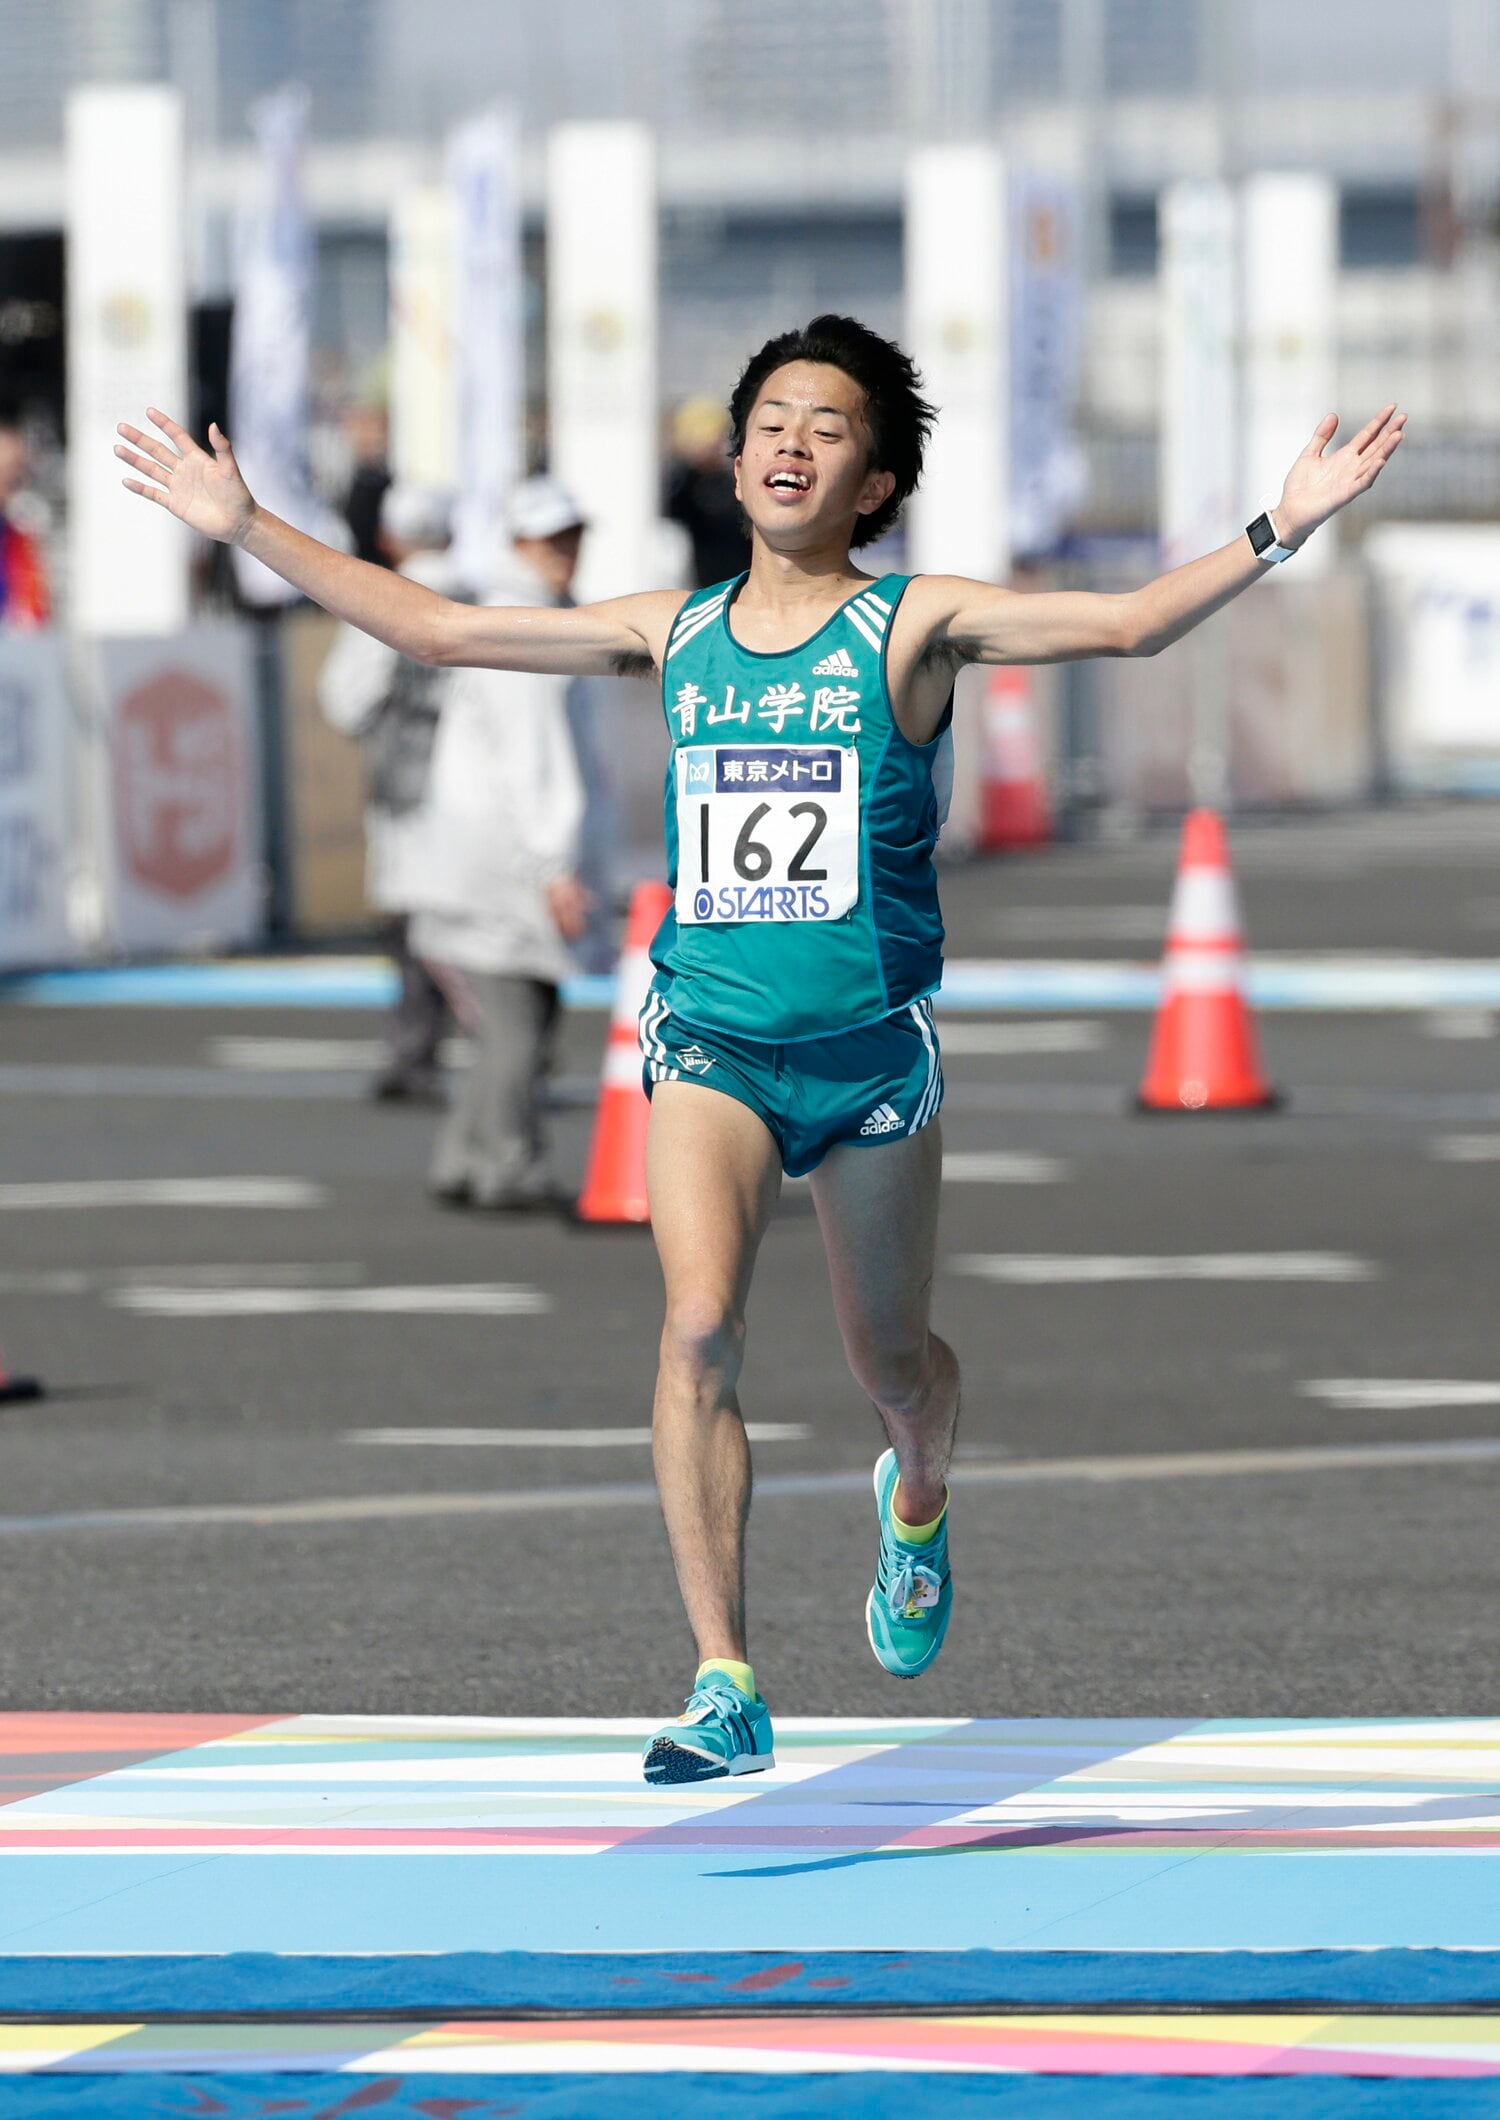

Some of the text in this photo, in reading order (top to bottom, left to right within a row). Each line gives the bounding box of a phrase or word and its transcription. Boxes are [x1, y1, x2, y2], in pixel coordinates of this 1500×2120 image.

[812, 664, 859, 678] adidas
[671, 682, 862, 736] 青山学院
[722, 759, 833, 782] 東京メトロ
[700, 801, 828, 883] 162
[860, 1120, 906, 1136] adidas
